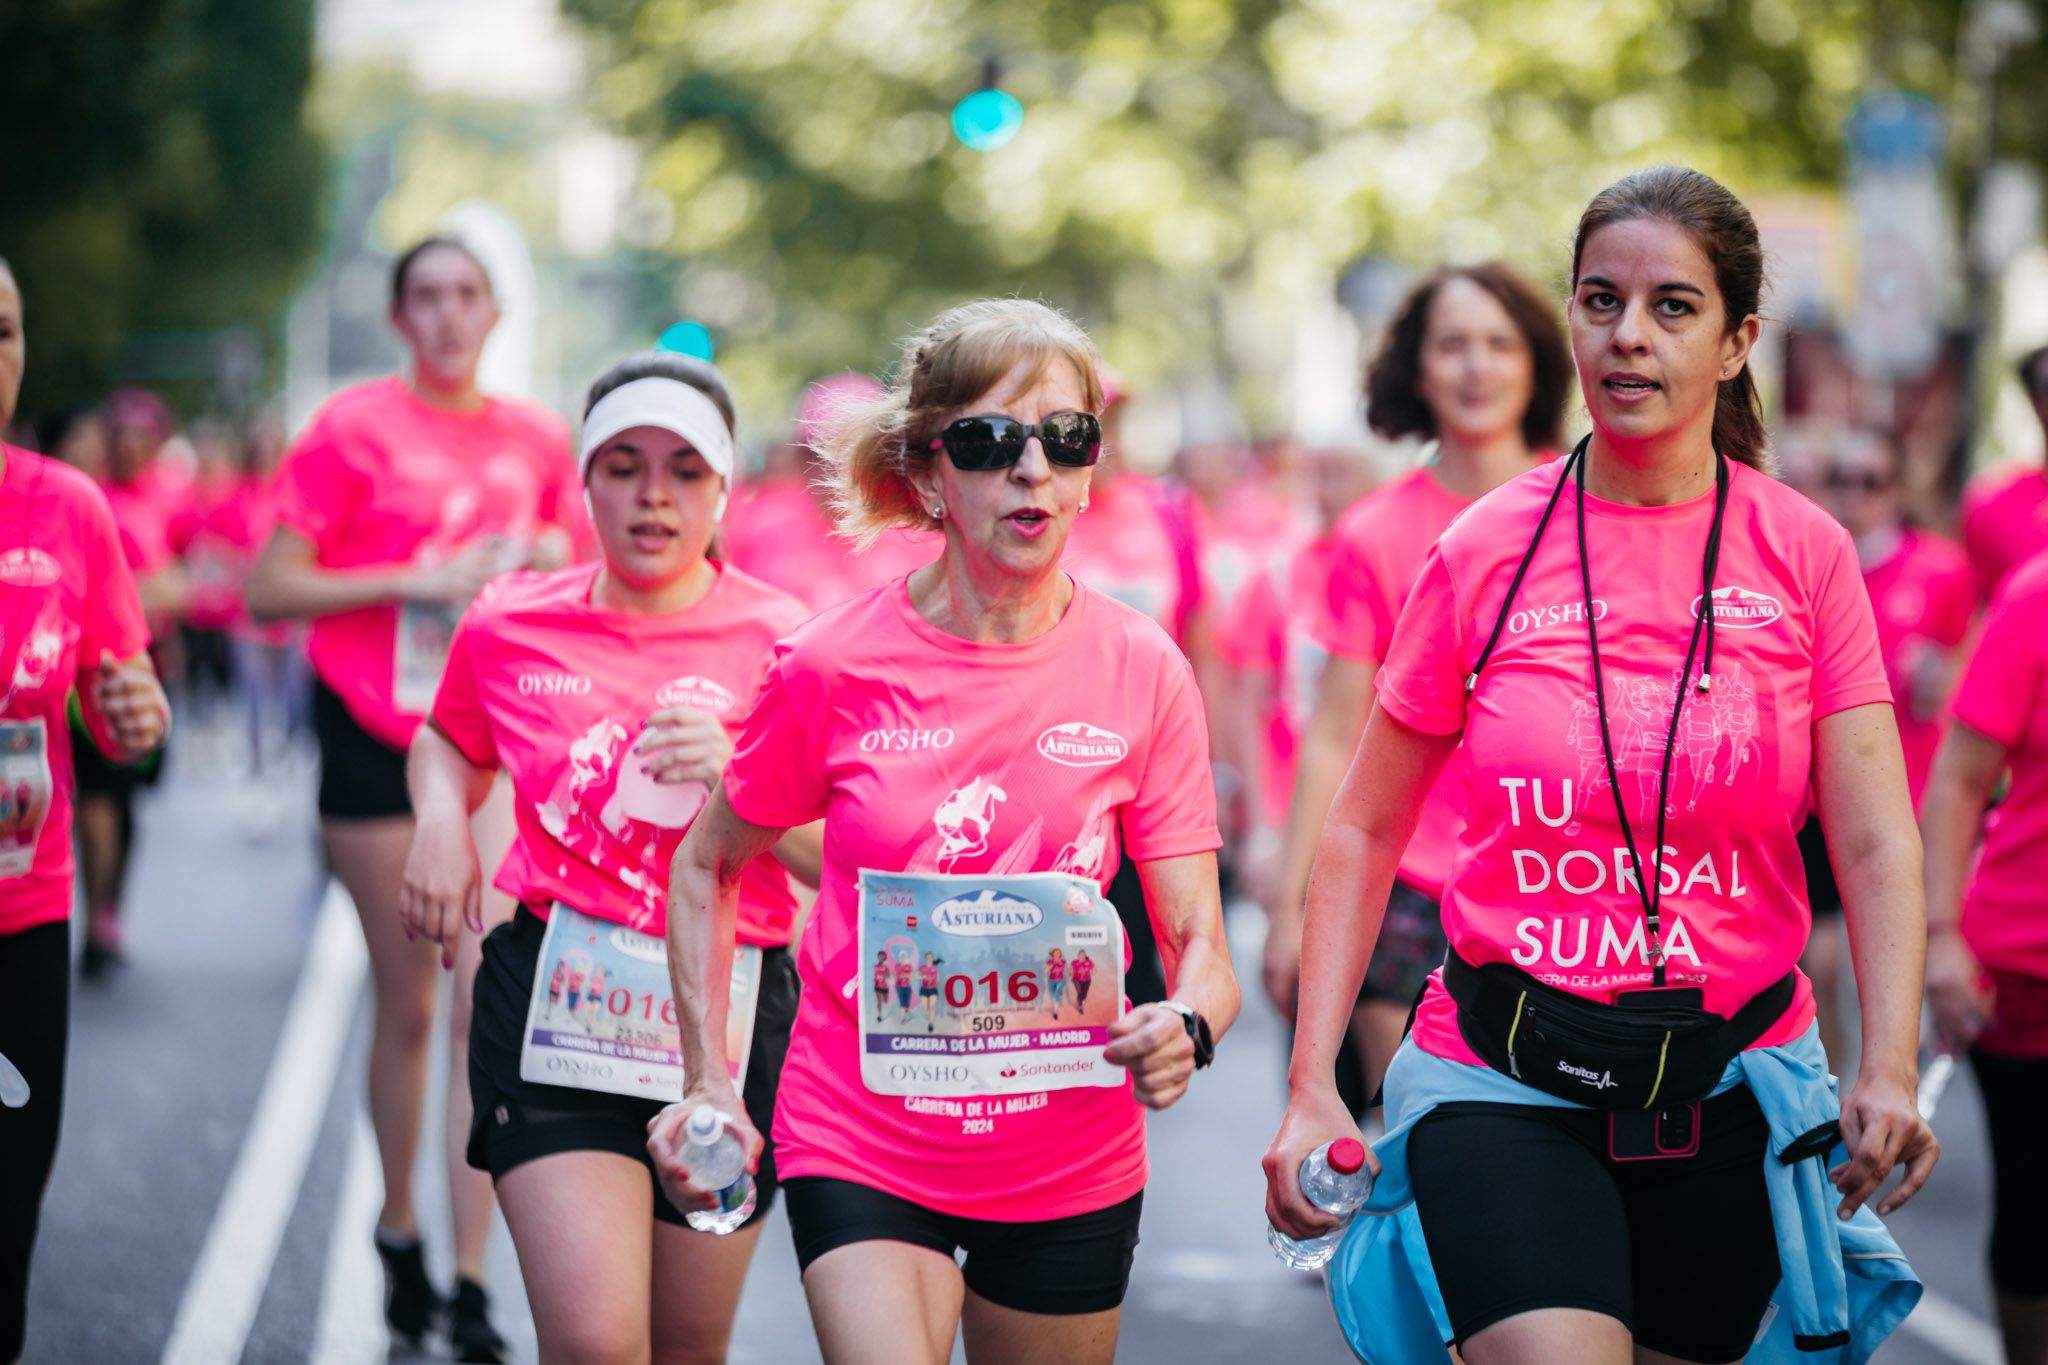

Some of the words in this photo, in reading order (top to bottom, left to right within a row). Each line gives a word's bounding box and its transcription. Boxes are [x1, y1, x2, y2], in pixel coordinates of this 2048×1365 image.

[1508, 599, 1608, 634] OYSHO
[1704, 605, 1776, 618] STURIANA
[518, 672, 593, 696] OYSHO
[859, 728, 955, 752] OYSHO
[1044, 735, 1121, 757] ASTURIANA
[1499, 777, 1573, 828] TU
[1511, 845, 1748, 899] DORSAL
[940, 908, 1035, 927] ASTURIANA
[1510, 914, 1702, 968] SUMA
[944, 970, 1040, 1008] 016
[1571, 975, 1591, 987] DE
[1592, 975, 1608, 987] LA
[972, 1014, 1005, 1032] 509
[890, 1036, 948, 1051] CARRERA
[951, 1038, 966, 1052] DE
[968, 1036, 986, 1051] LA
[988, 1034, 1030, 1050] MUJER
[1040, 1030, 1091, 1046] MADRID
[890, 1063, 968, 1082] OYSHO
[1020, 1060, 1095, 1077] Santander
[1557, 1060, 1599, 1080] Sanitas
[904, 1096, 963, 1117] CARRERA
[966, 1101, 984, 1117] DE
[987, 1101, 1003, 1116] LA
[1006, 1092, 1048, 1114] MUJER
[962, 1118, 994, 1134] 2024
